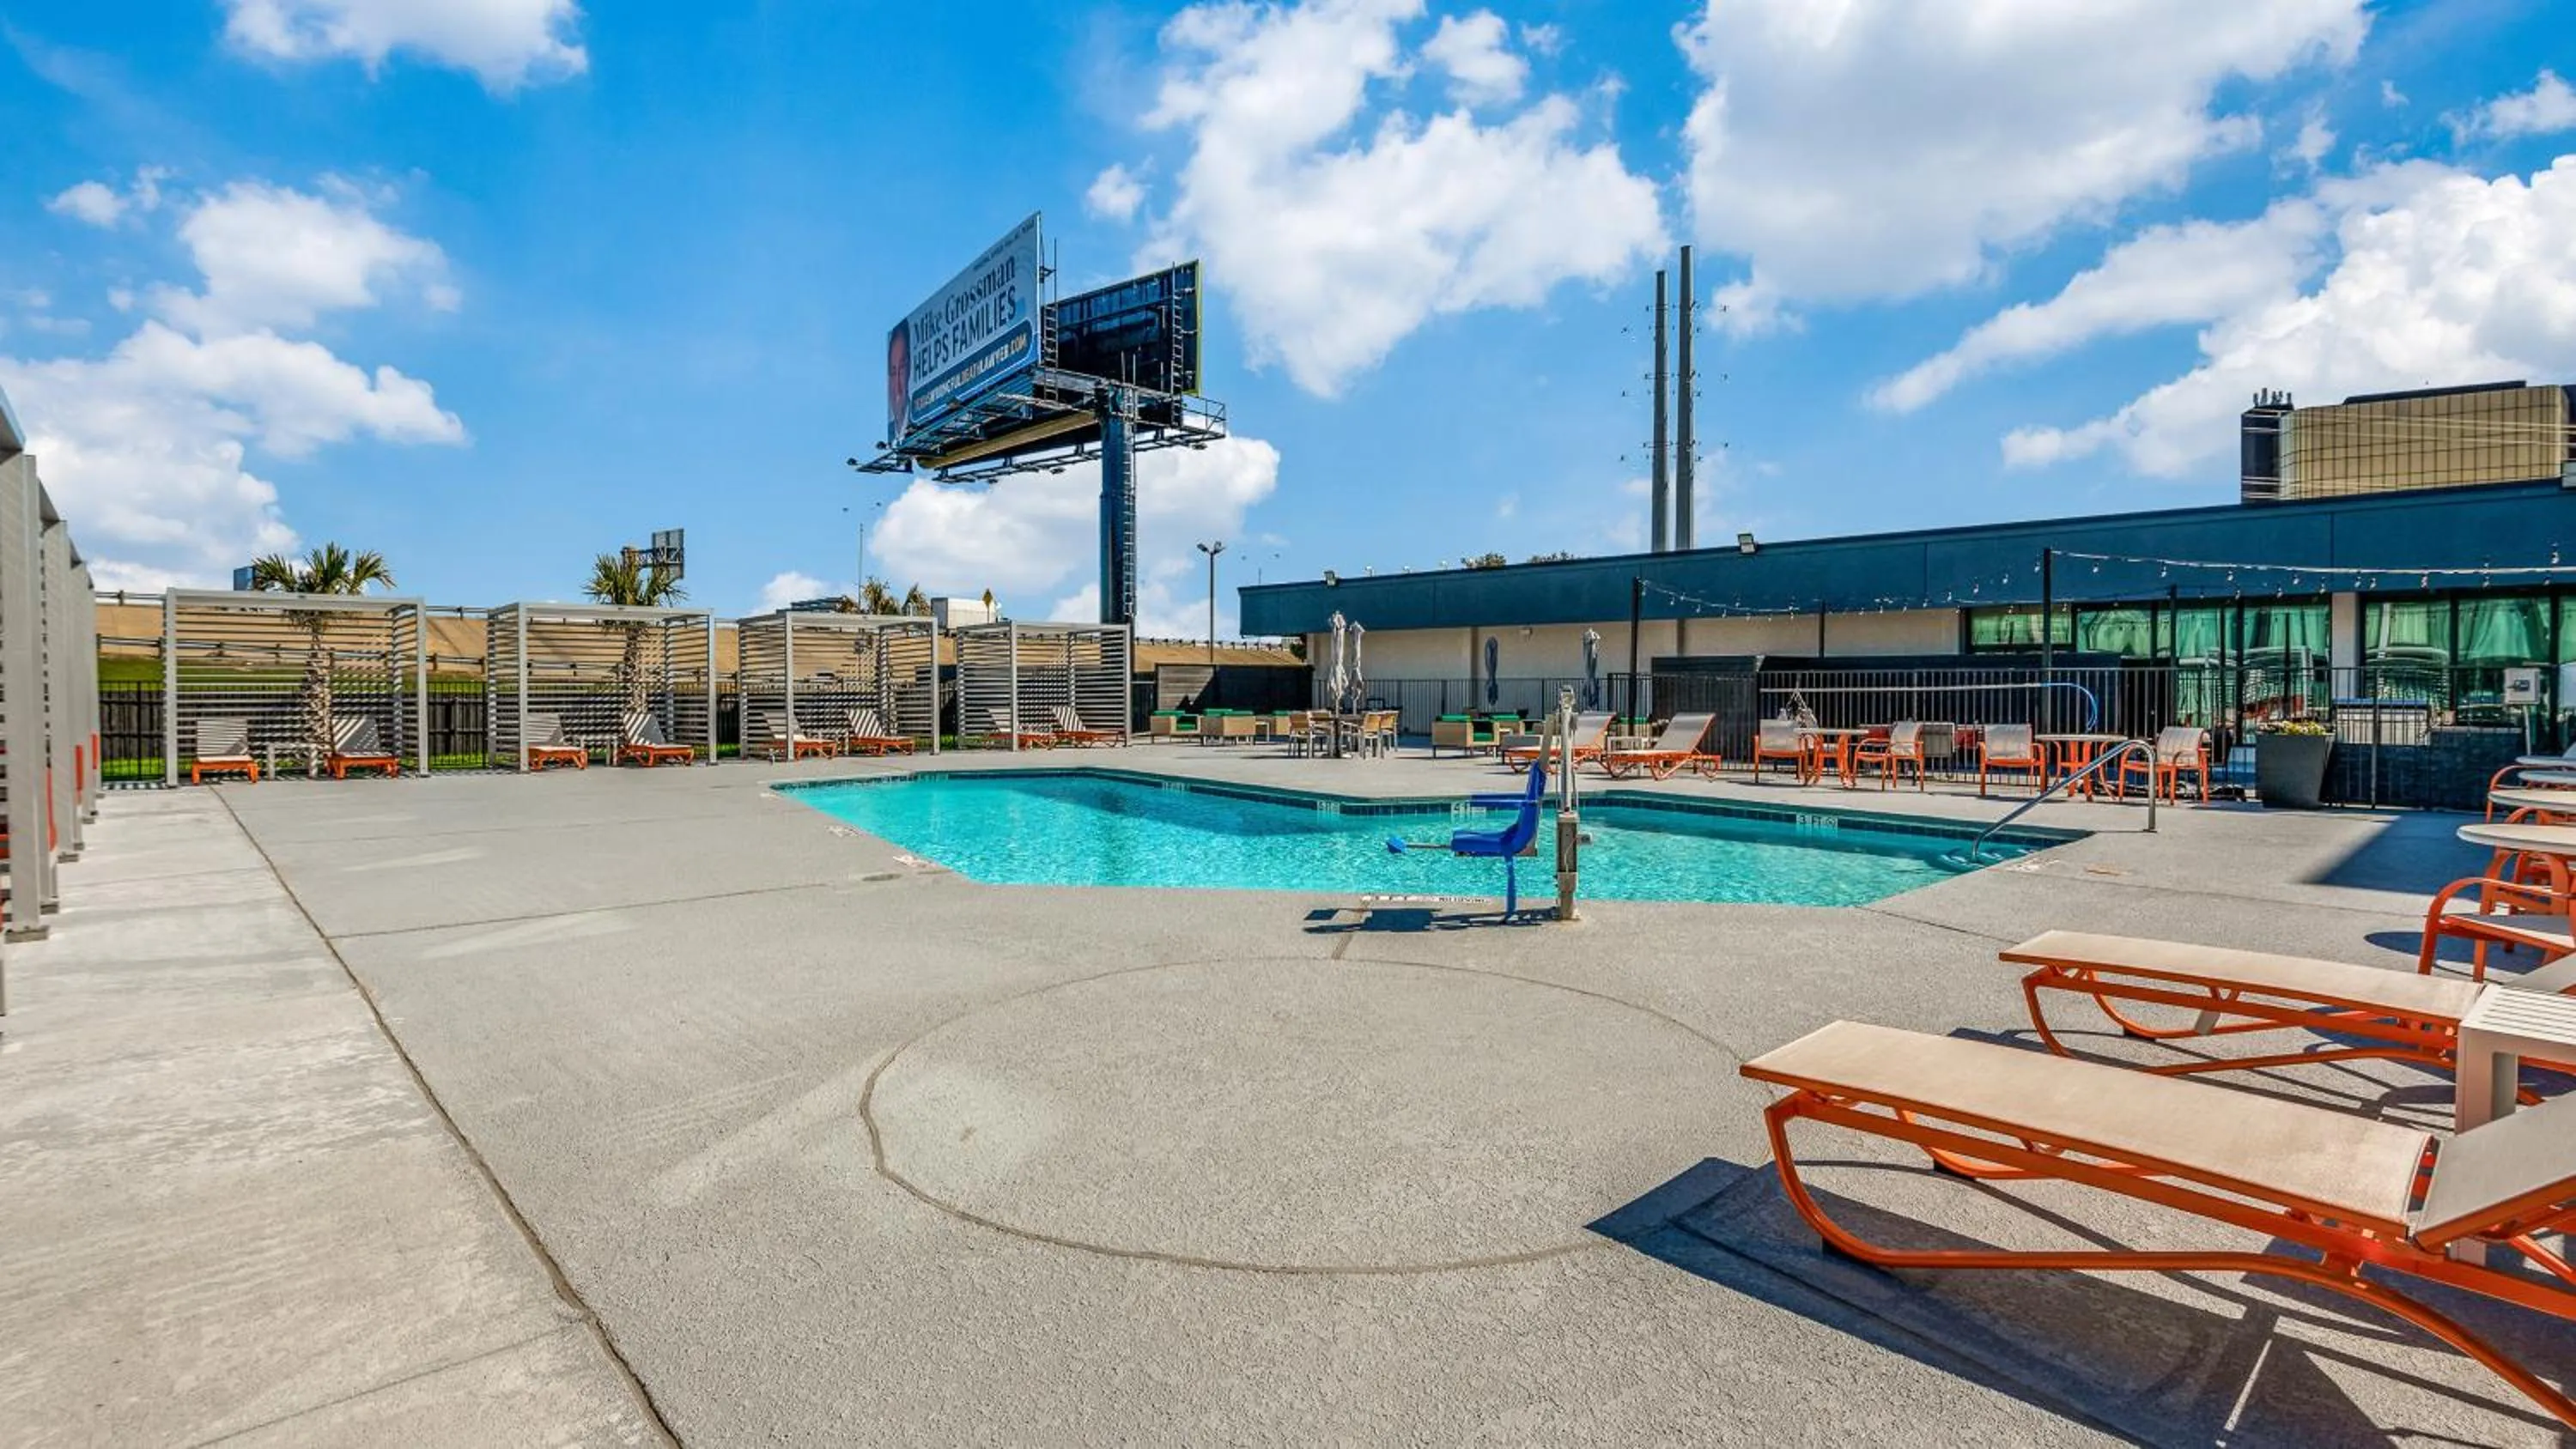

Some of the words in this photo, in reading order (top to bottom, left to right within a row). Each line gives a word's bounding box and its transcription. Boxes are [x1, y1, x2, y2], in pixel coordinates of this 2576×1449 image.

[914, 309, 942, 345] Mike
[945, 256, 1016, 325] Grossman
[914, 333, 949, 384] HELPS
[951, 285, 1016, 358] FAMILIES
